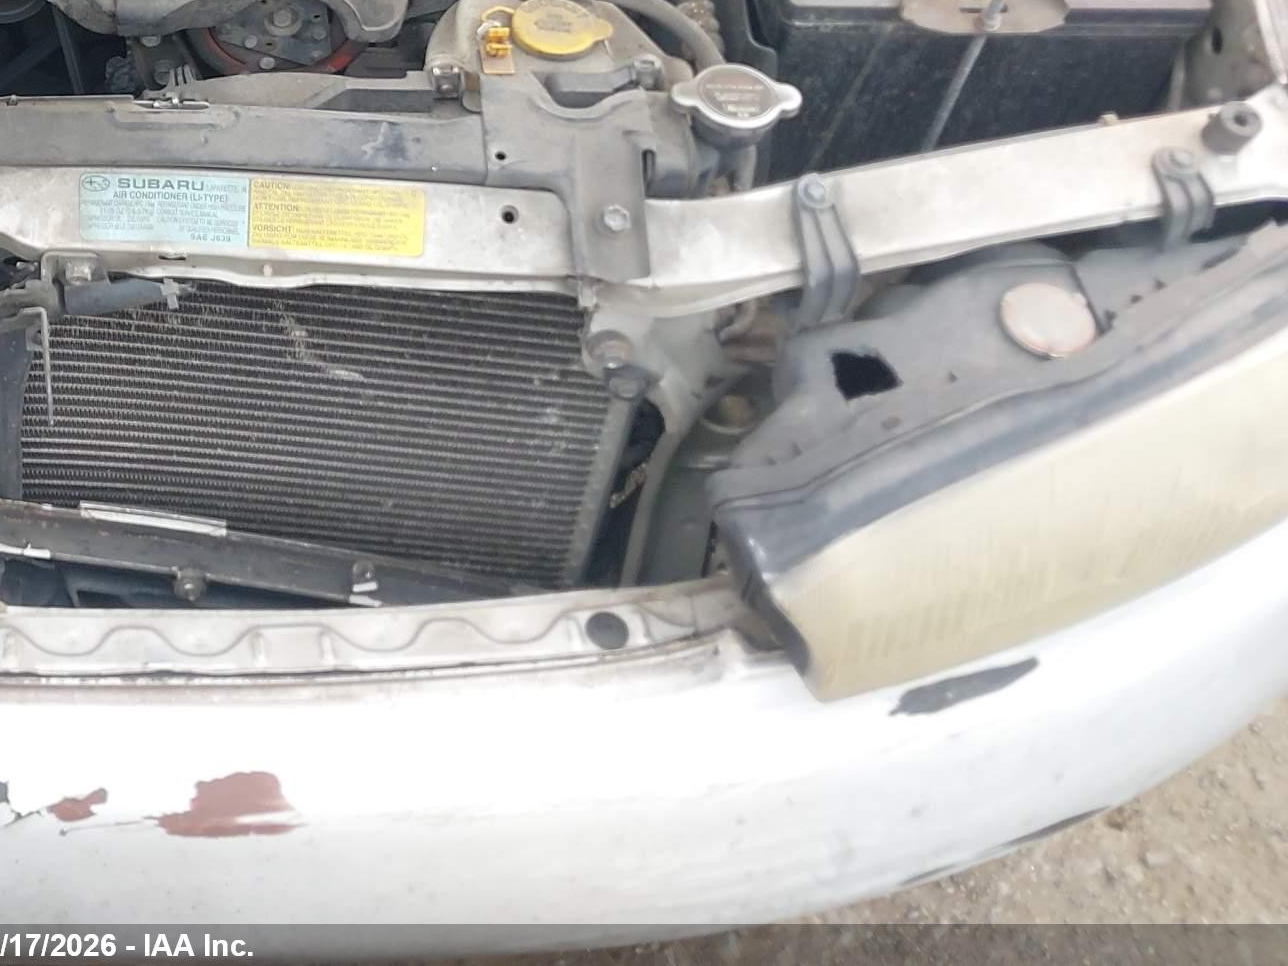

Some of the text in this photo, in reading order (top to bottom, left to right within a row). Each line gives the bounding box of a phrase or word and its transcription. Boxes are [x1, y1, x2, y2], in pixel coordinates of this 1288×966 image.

[117, 177, 205, 191] SUBARU
[113, 191, 128, 199] AIR
[129, 191, 188, 201] CONDITIONER
